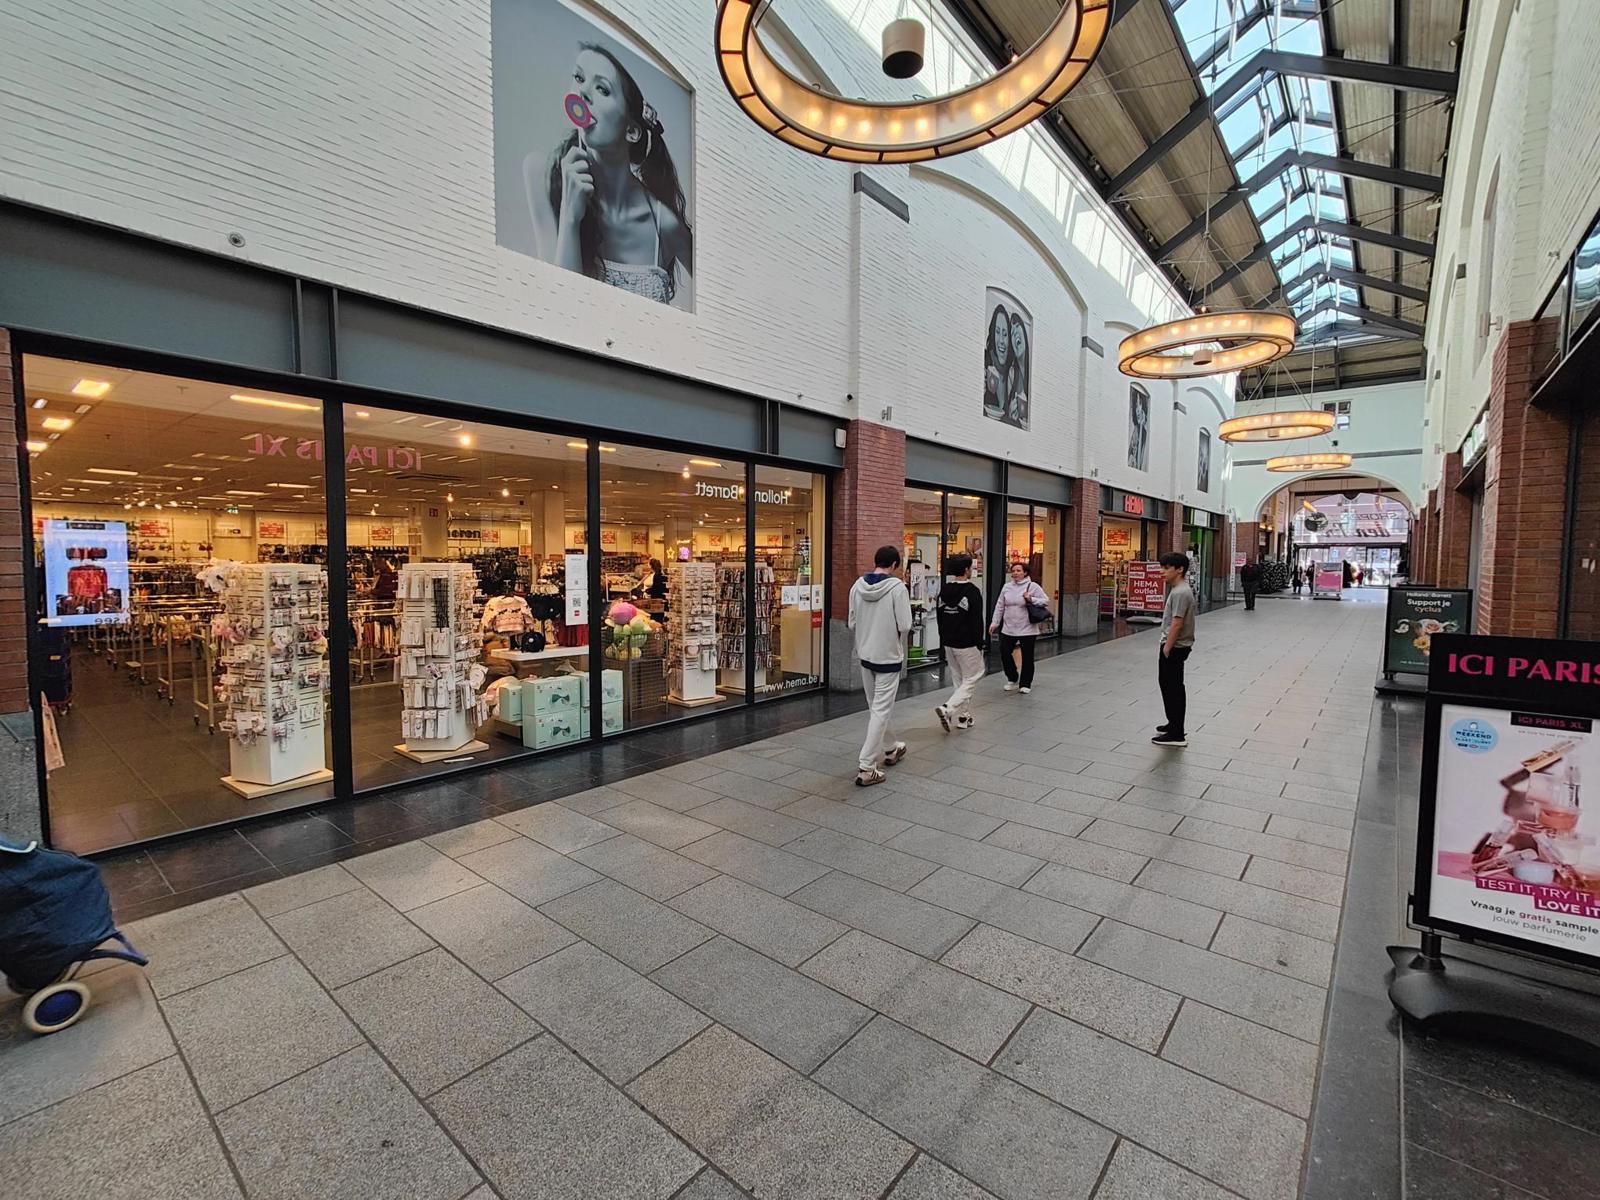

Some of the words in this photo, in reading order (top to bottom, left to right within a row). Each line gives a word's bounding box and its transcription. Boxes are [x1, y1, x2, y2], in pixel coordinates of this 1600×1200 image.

[1125, 495, 1144, 515] HEMA
[1133, 580, 1159, 588] HEMA
[1407, 598, 1441, 607] Support
[1442, 599, 1451, 607] je
[1448, 653, 1494, 676] ICI
[762, 675, 818, 693] www.hema.be
[1518, 716, 1533, 724] ICI
[1535, 718, 1566, 727] PARIS
[1570, 721, 1585, 729] XL
[1456, 731, 1492, 739] WEEKEND
[1480, 878, 1515, 892] TEST
[1540, 886, 1571, 899] TRY
[1576, 891, 1591, 902] IT
[1470, 899, 1502, 913] Vraag
[1504, 907, 1516, 916] je
[1519, 910, 1551, 924] gratis
[1538, 899, 1580, 914] LOVE
[1586, 906, 1600, 918] IT
[1492, 915, 1519, 926] jouw
[1523, 922, 1587, 941] parfumerie
